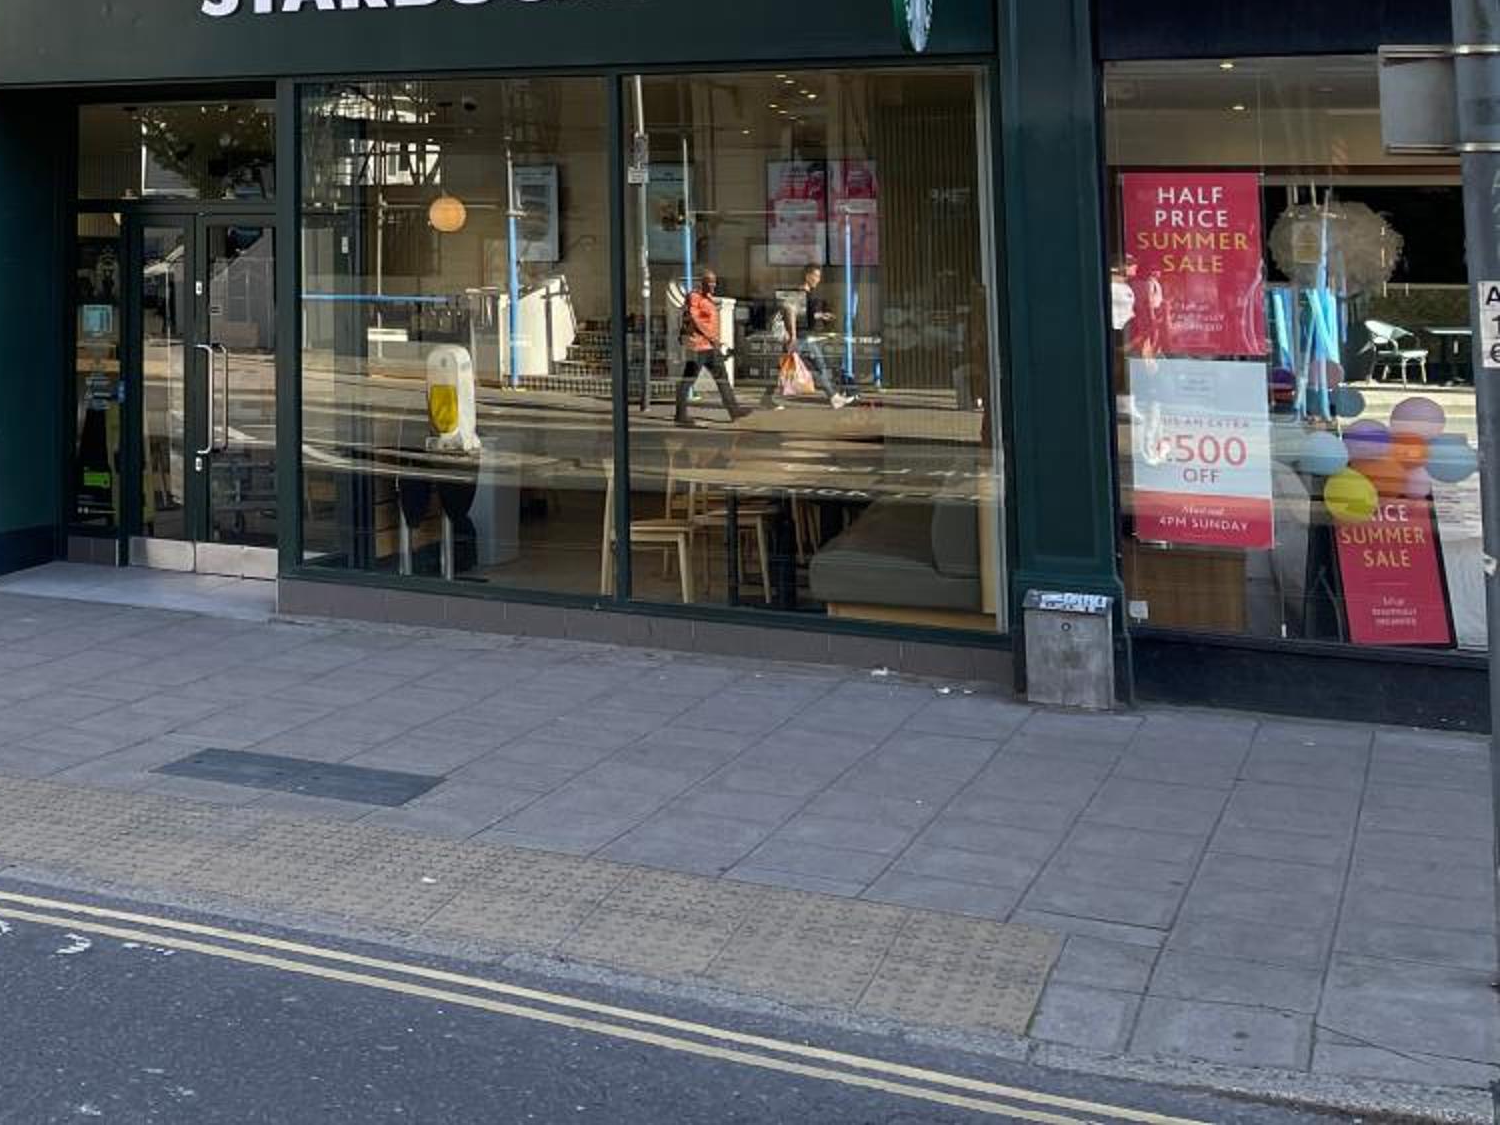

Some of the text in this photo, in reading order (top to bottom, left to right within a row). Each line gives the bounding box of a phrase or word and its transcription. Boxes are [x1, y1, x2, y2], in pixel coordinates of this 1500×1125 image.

[1157, 186, 1224, 204] HALF
[1154, 210, 1229, 228] PRICE
[1137, 232, 1249, 251] SUMMER
[1162, 255, 1225, 273] SALE
[1182, 468, 1221, 484] OFF
[1159, 515, 1249, 532] 4PM SUNDAY
[1340, 527, 1426, 545] SUMMER
[1363, 550, 1412, 568] SALE
